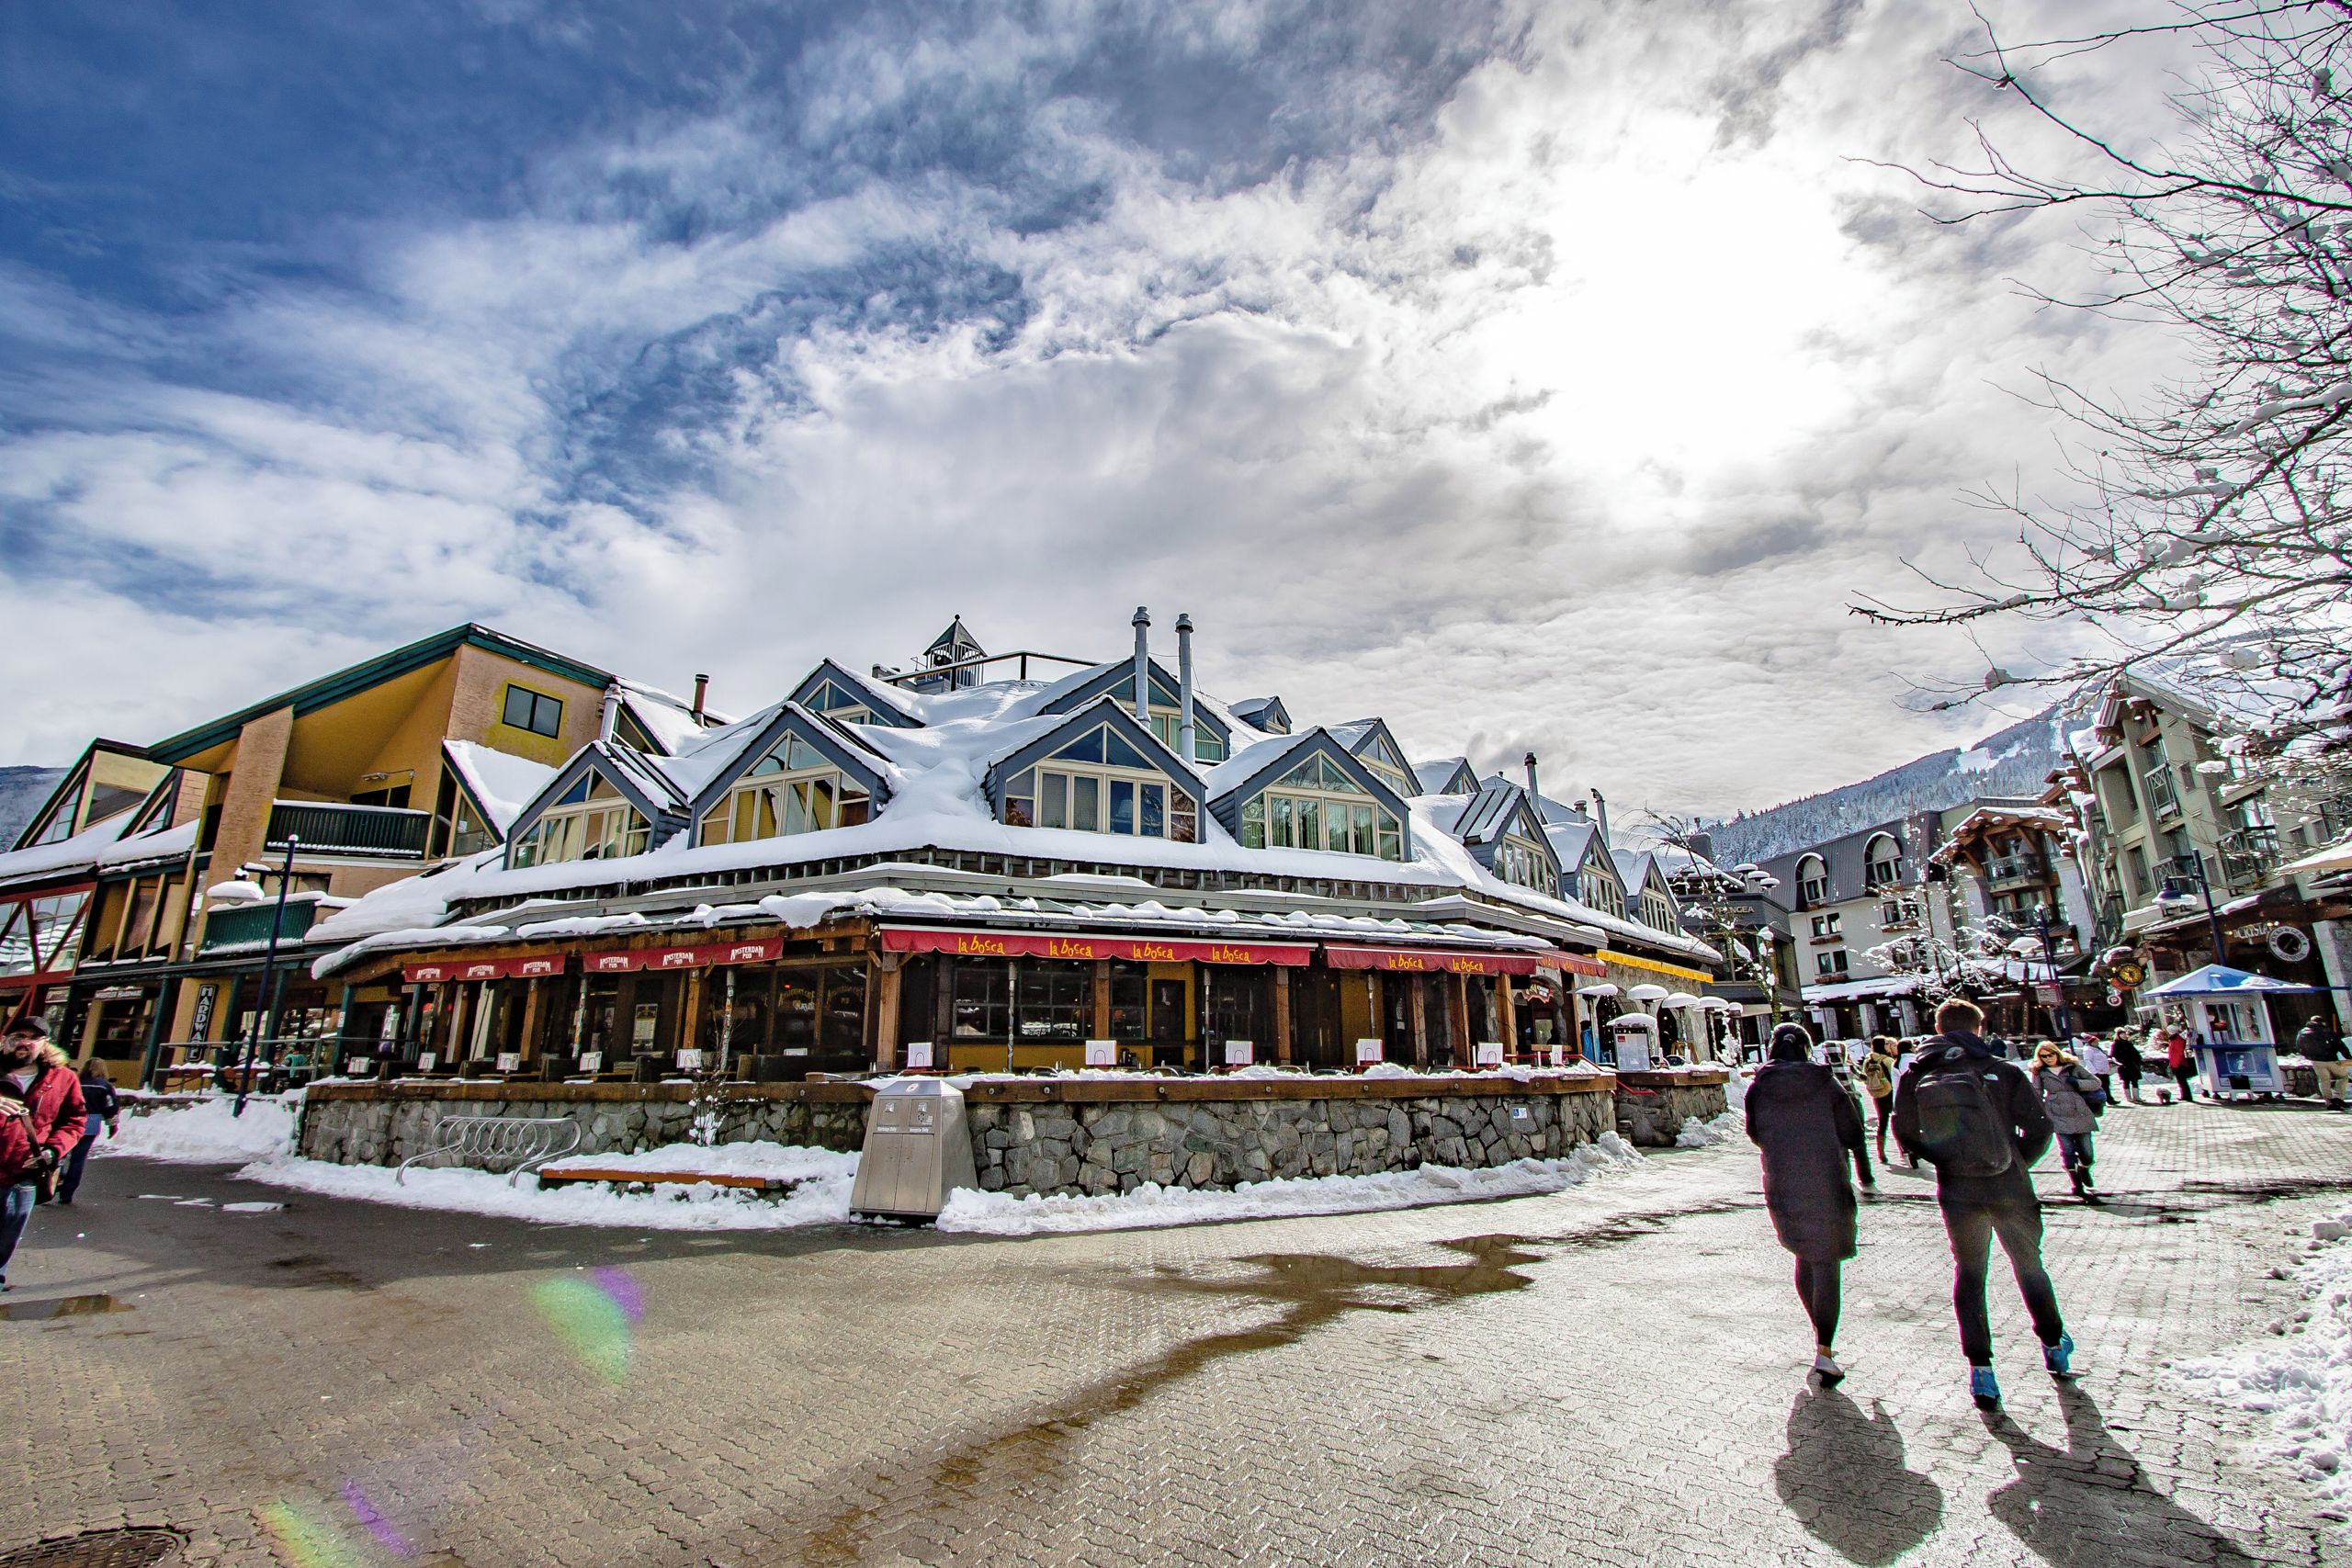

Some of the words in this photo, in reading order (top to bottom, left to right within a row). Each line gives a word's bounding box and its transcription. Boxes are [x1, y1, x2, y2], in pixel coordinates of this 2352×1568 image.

[729, 945, 764, 962] AMSTERDAM
[958, 937, 968, 953] la
[970, 935, 1005, 955] bocca
[1049, 941, 1058, 956] la
[1061, 939, 1093, 958] bocca
[1133, 943, 1142, 959] la
[1144, 942, 1175, 961] bocca
[599, 956, 628, 969] AMSTERDAM
[662, 952, 694, 966] AMSTERDAM
[1212, 946, 1221, 962] la
[1223, 945, 1250, 964] bocca
[1388, 955, 1396, 969] la
[1398, 953, 1424, 970] bocca
[1453, 957, 1461, 972] la
[1461, 956, 1484, 973] bocca
